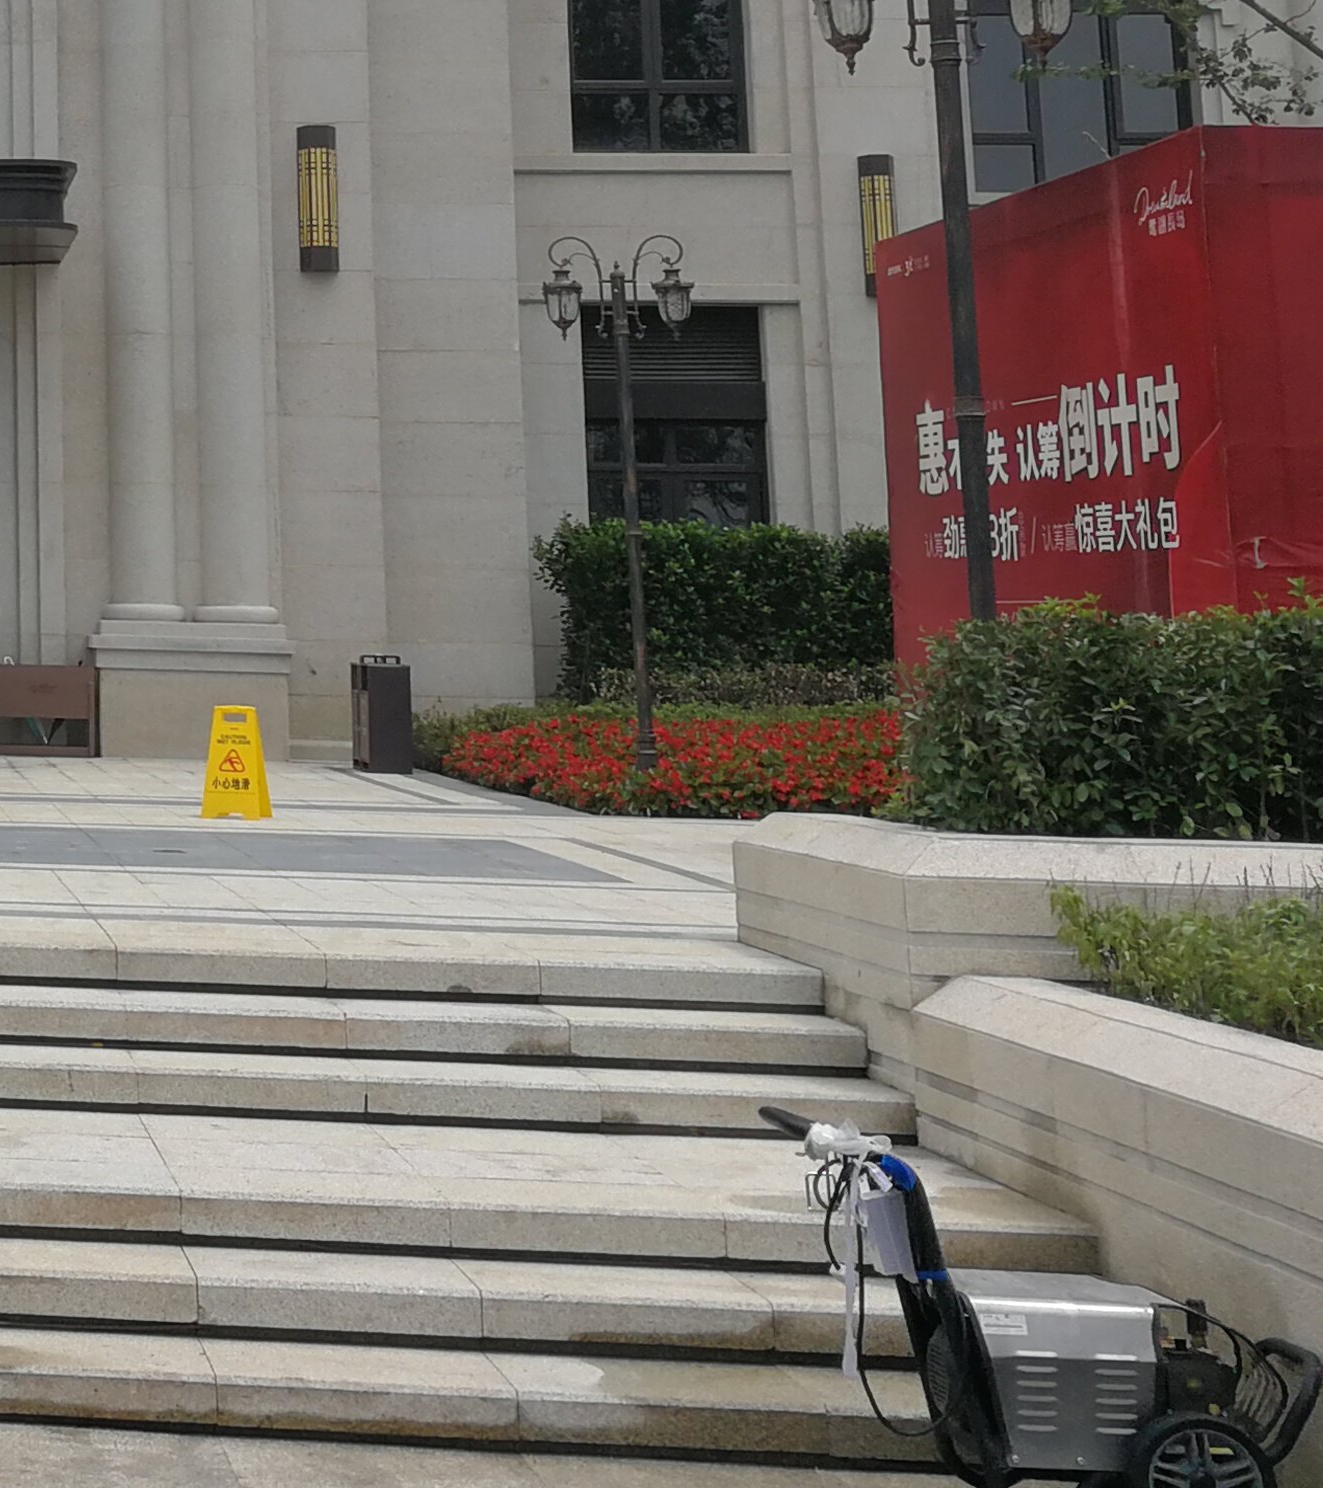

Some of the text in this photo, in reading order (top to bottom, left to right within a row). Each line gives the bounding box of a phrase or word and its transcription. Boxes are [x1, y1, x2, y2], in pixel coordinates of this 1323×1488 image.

[915, 364, 1181, 496] 惠不失 认筹倒计时
[212, 776, 251, 791] 小心地滑
